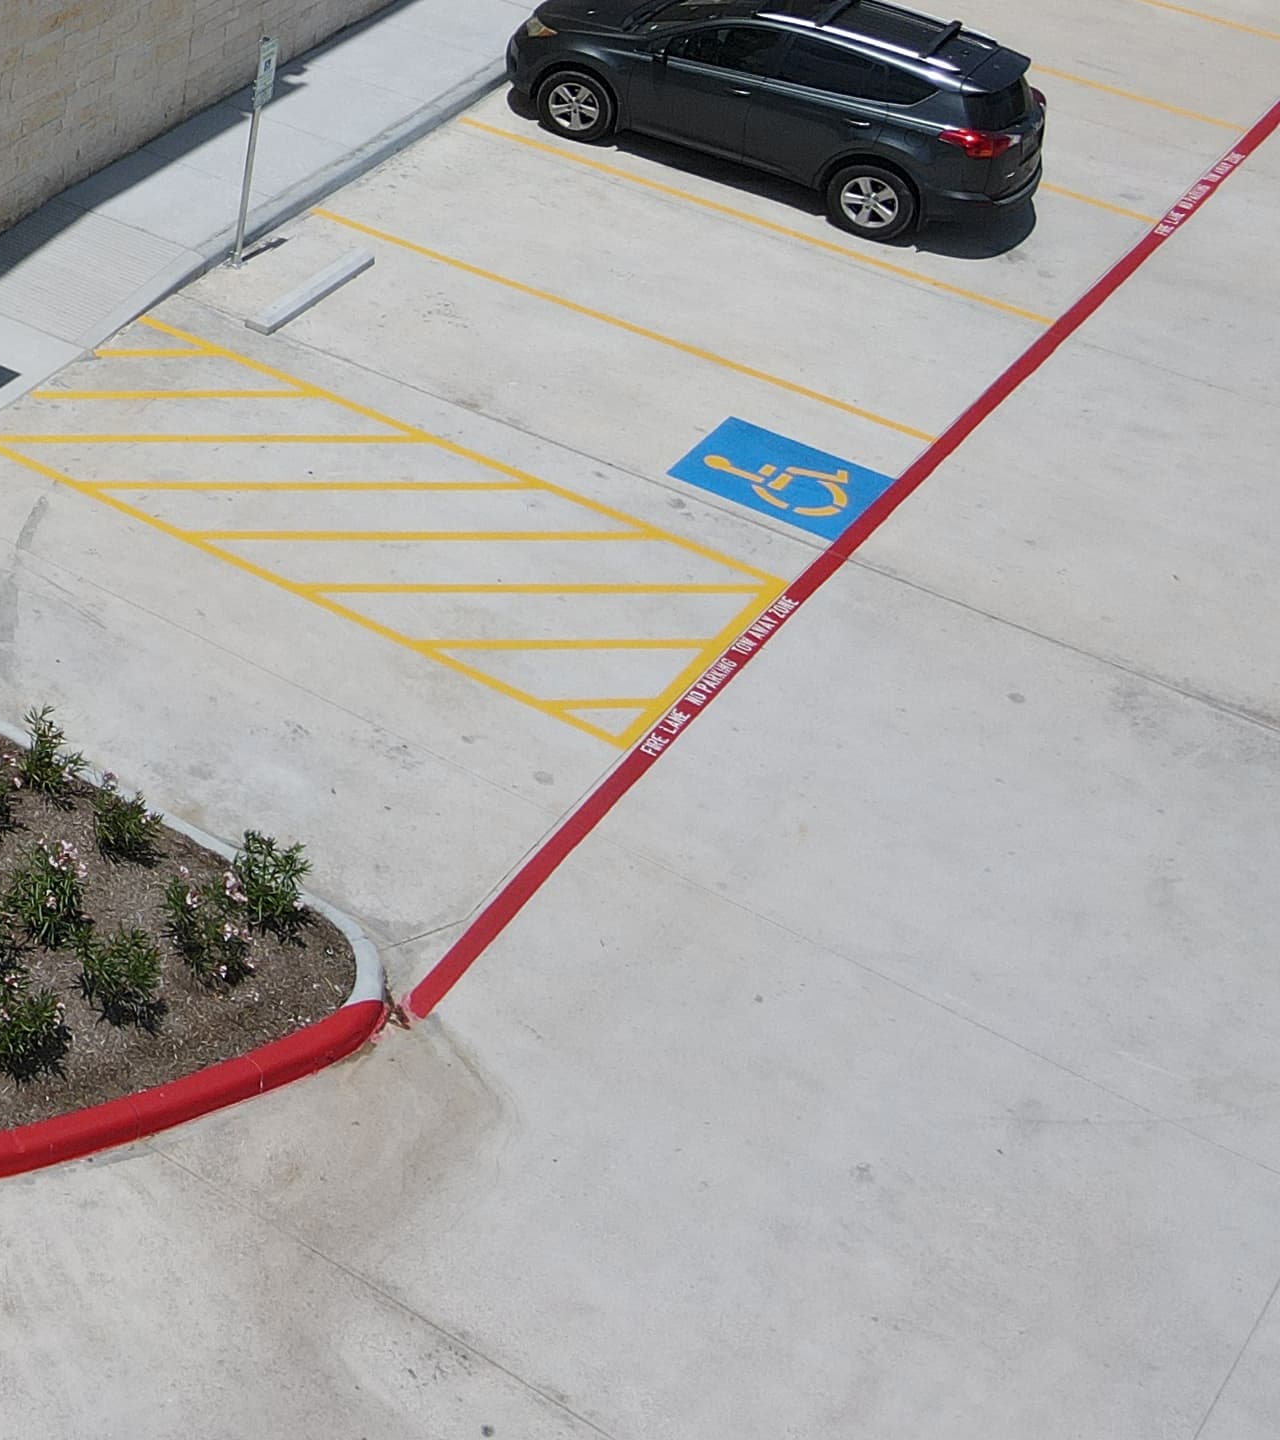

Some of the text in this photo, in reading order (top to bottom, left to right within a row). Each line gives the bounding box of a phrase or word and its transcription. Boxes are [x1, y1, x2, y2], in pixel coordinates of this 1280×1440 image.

[640, 596, 800, 757] FIRE LANE NO PARKING TOW AWAY ZONE
